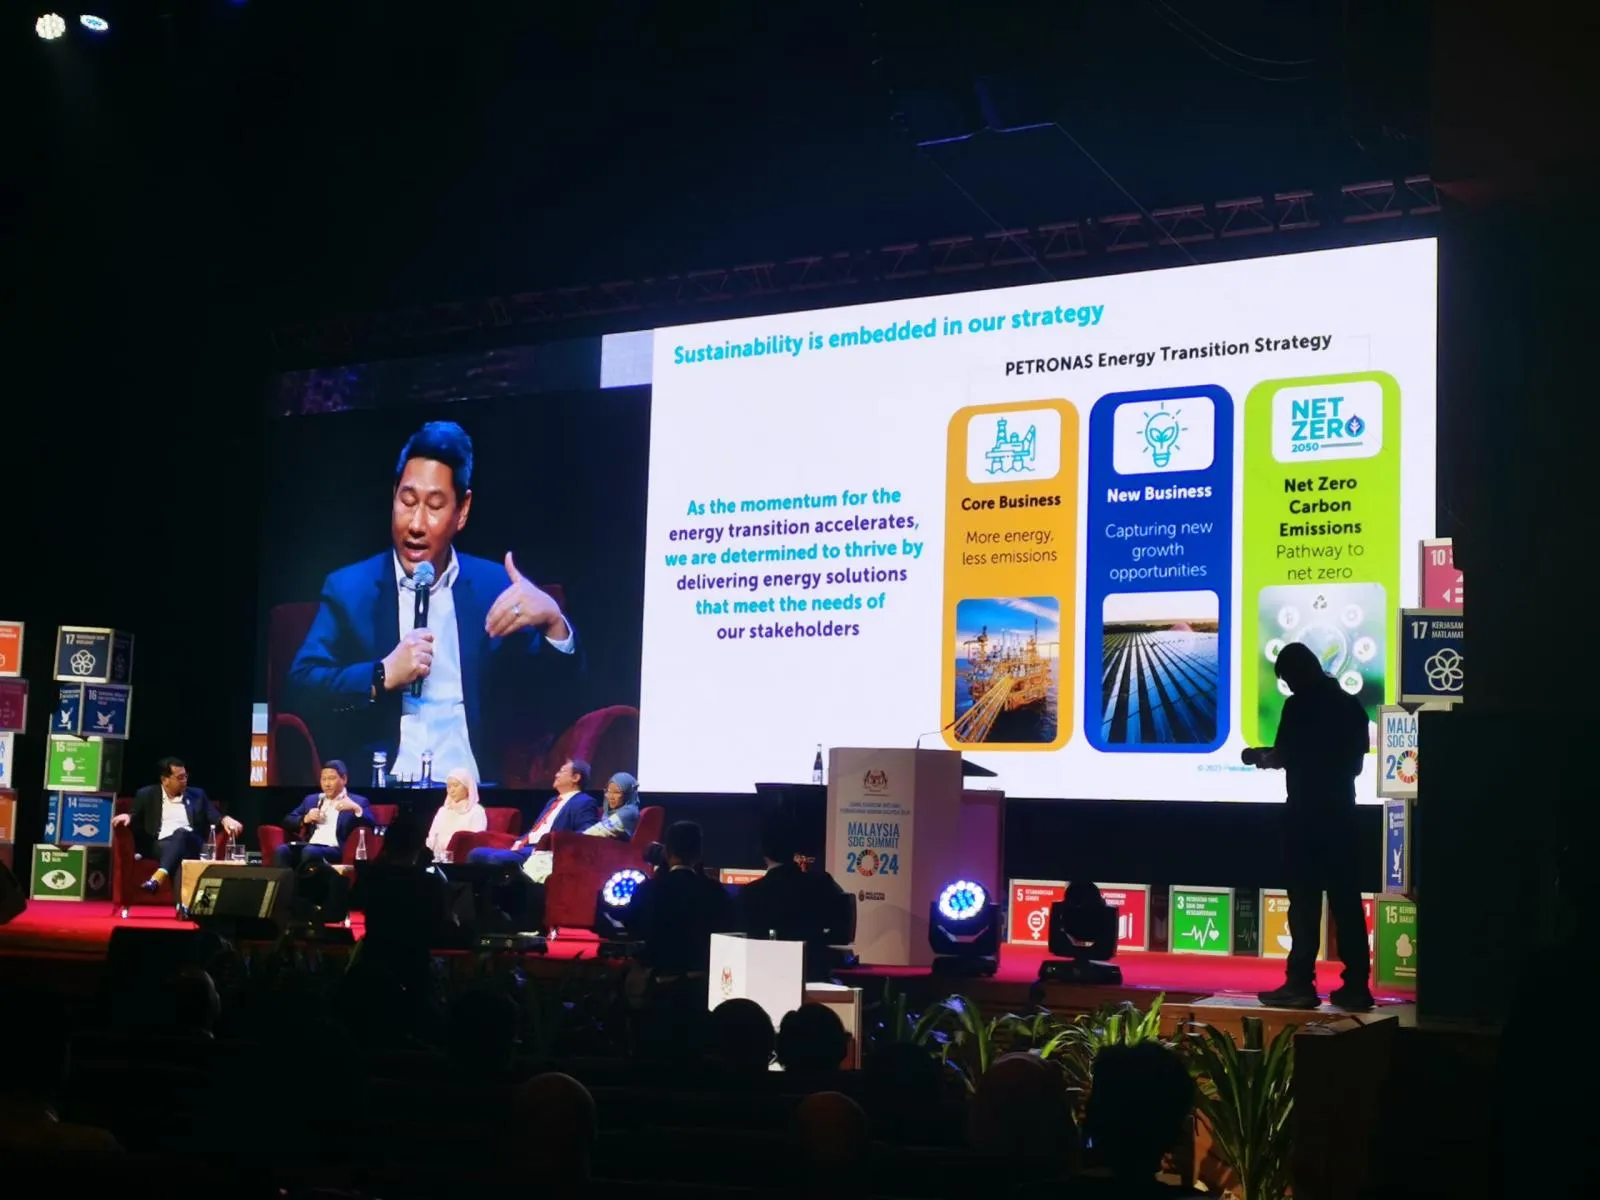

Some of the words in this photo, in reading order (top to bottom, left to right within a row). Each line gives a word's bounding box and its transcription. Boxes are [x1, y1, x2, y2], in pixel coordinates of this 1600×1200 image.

[674, 335, 803, 364] Sustainability
[809, 332, 823, 350] is
[829, 318, 936, 347] embedded
[944, 316, 962, 335] in
[968, 315, 1006, 333] our
[1012, 305, 1104, 329] strategy
[1006, 354, 1093, 376] PETRONAS
[1099, 352, 1155, 367] Energy
[1160, 341, 1249, 360] Transition
[1255, 335, 1331, 352] Strategy
[1292, 397, 1344, 419] NET
[1292, 443, 1319, 452] 2050
[1285, 479, 1313, 492] Net
[1318, 477, 1357, 490] Zero
[687, 500, 705, 515] As
[710, 498, 736, 514] the
[741, 494, 837, 512] momentum
[842, 490, 867, 506] for
[872, 488, 901, 504] the
[1108, 489, 1140, 502] New
[1145, 485, 1212, 500] Business
[962, 498, 995, 510] Core
[1000, 495, 1061, 508] Business
[1290, 499, 1351, 514] Carbon
[669, 528, 724, 543] energy
[729, 520, 809, 537] transition
[815, 514, 918, 533] accelerates,
[1105, 523, 1176, 540] Capturing
[1182, 523, 1213, 534] new
[1280, 521, 1361, 537] Emissions
[967, 532, 1000, 544] More
[665, 554, 687, 566] we
[691, 553, 716, 565] are
[721, 544, 817, 563] determined
[822, 544, 840, 558] to
[845, 540, 897, 557] thrive
[902, 539, 923, 559] by
[963, 552, 986, 565] less
[991, 551, 1057, 563] emissions
[1132, 543, 1184, 560] growth
[1277, 545, 1342, 560] Pathway
[1348, 544, 1364, 556] to
[1431, 549, 1446, 566] 10
[677, 573, 758, 591] delivering
[763, 573, 821, 589] energy
[827, 567, 907, 584] solutions
[1110, 564, 1207, 582] opportunities
[1288, 567, 1312, 580] net
[1318, 568, 1352, 579] zero
[696, 599, 728, 615] that
[734, 598, 774, 613] meet
[779, 596, 807, 611] the
[812, 594, 862, 611] needs
[867, 592, 885, 609] of
[717, 628, 745, 639] our
[750, 621, 859, 638] stakeholders
[1411, 621, 1428, 639] 17
[1431, 622, 1464, 630] KERJASAM
[65, 634, 76, 645] 17
[1387, 718, 1417, 734] MALA
[1387, 735, 1405, 748] SDG
[68, 797, 78, 808] 14
[847, 821, 900, 838] MALAYSIA
[848, 836, 865, 848] SDG
[867, 837, 900, 849] SUMMIT
[41, 851, 51, 863] 13
[847, 849, 900, 876] 2024
[1017, 888, 1024, 901] 5
[1177, 896, 1185, 910] 3
[1268, 898, 1276, 912] 2
[1385, 905, 1398, 924] 15
